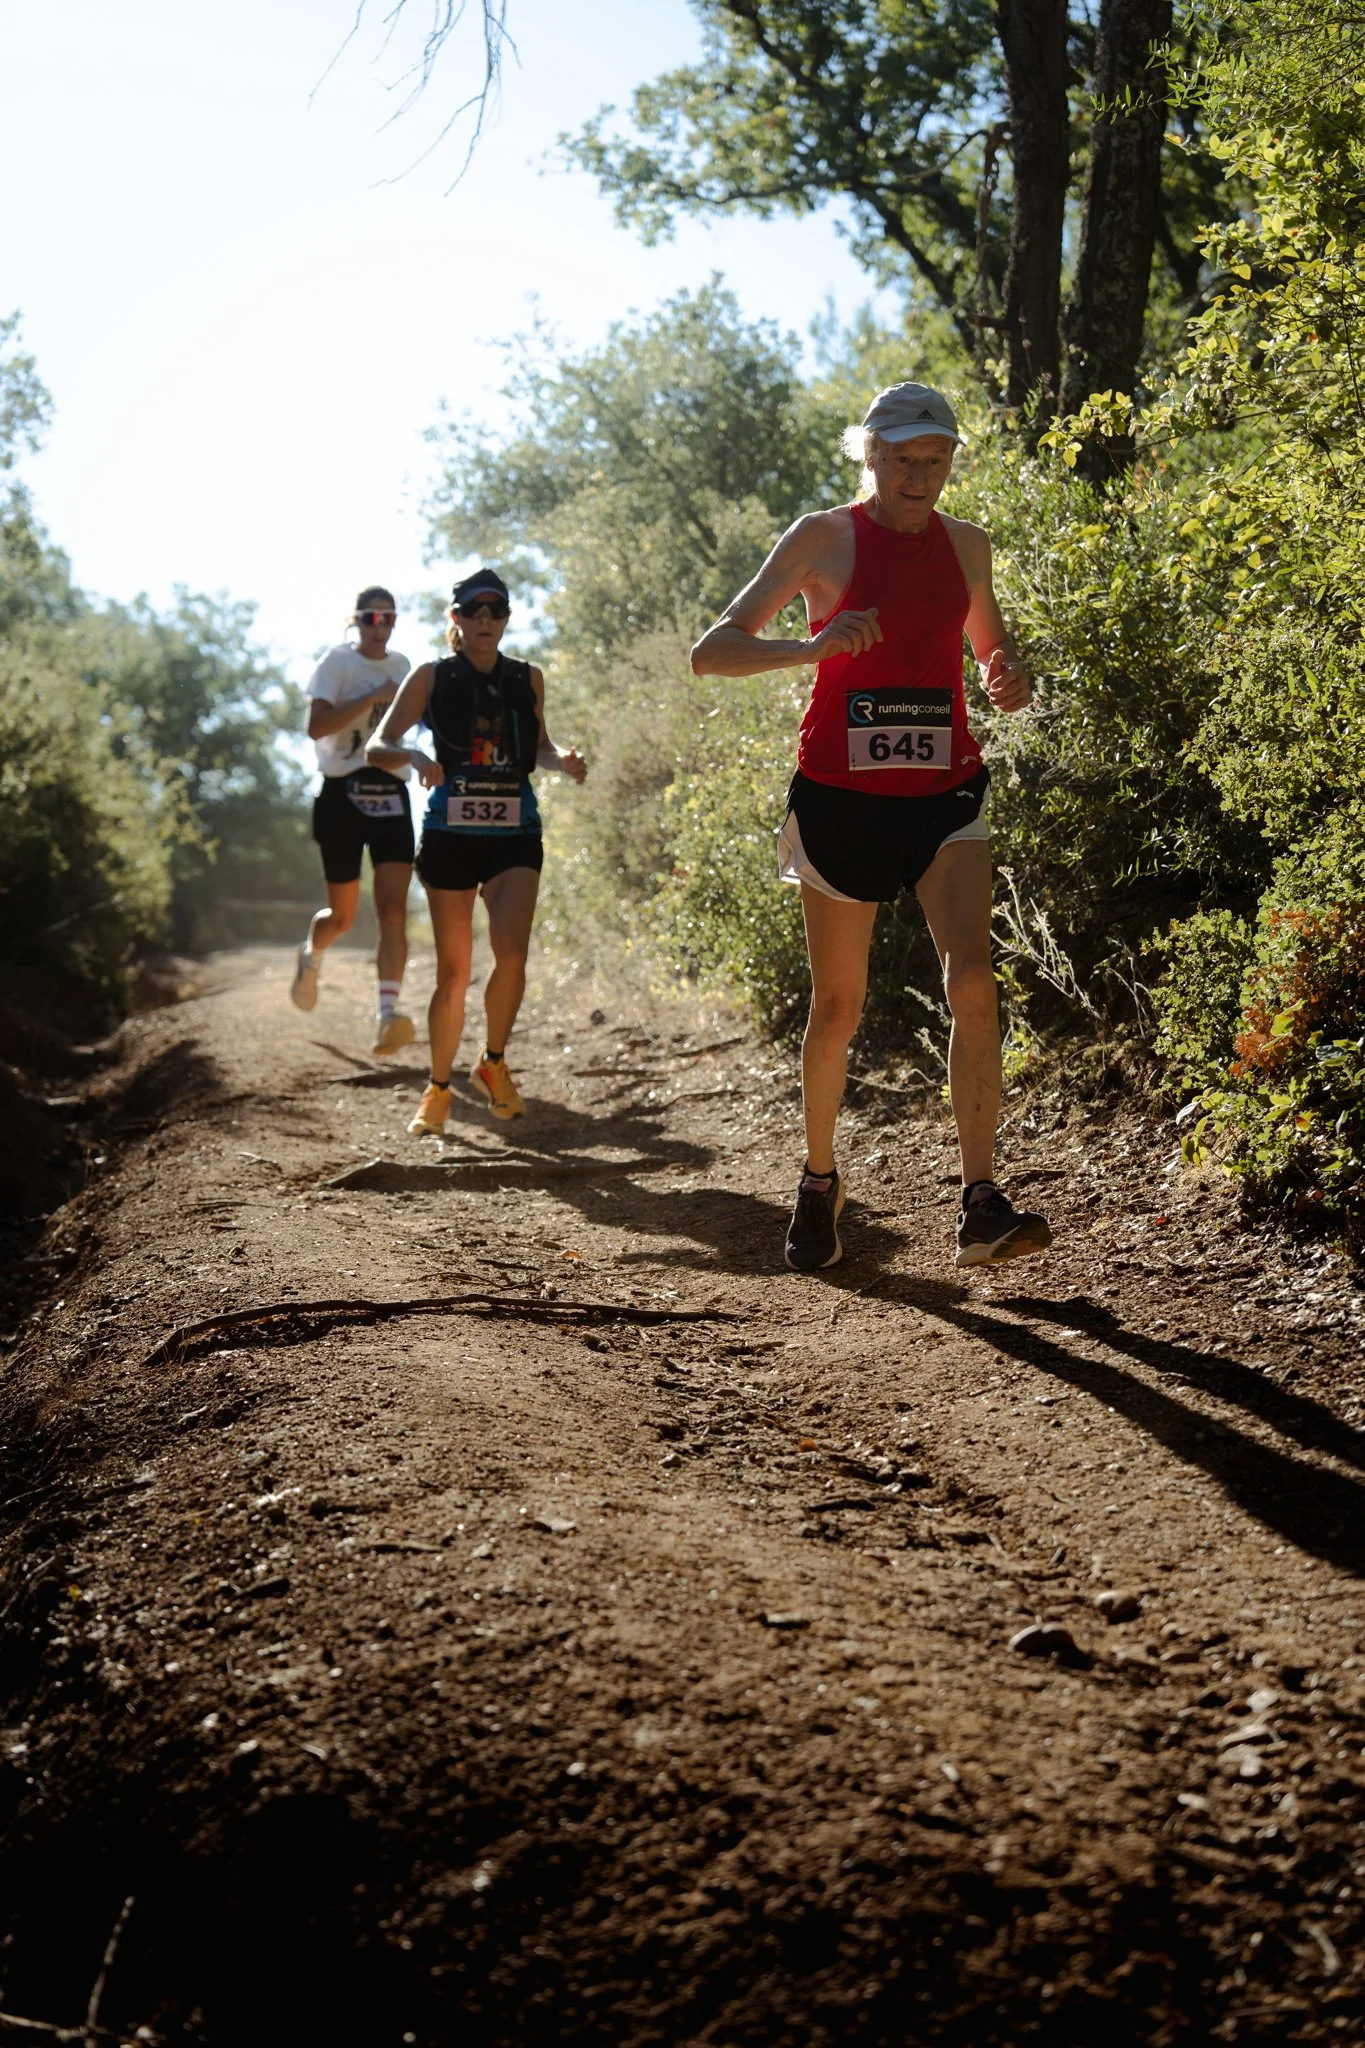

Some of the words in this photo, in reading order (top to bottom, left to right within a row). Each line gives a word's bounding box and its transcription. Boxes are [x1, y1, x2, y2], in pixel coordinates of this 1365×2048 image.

[878, 703, 951, 716] runningconseil
[868, 732, 935, 762] 645
[461, 802, 508, 821] 532
